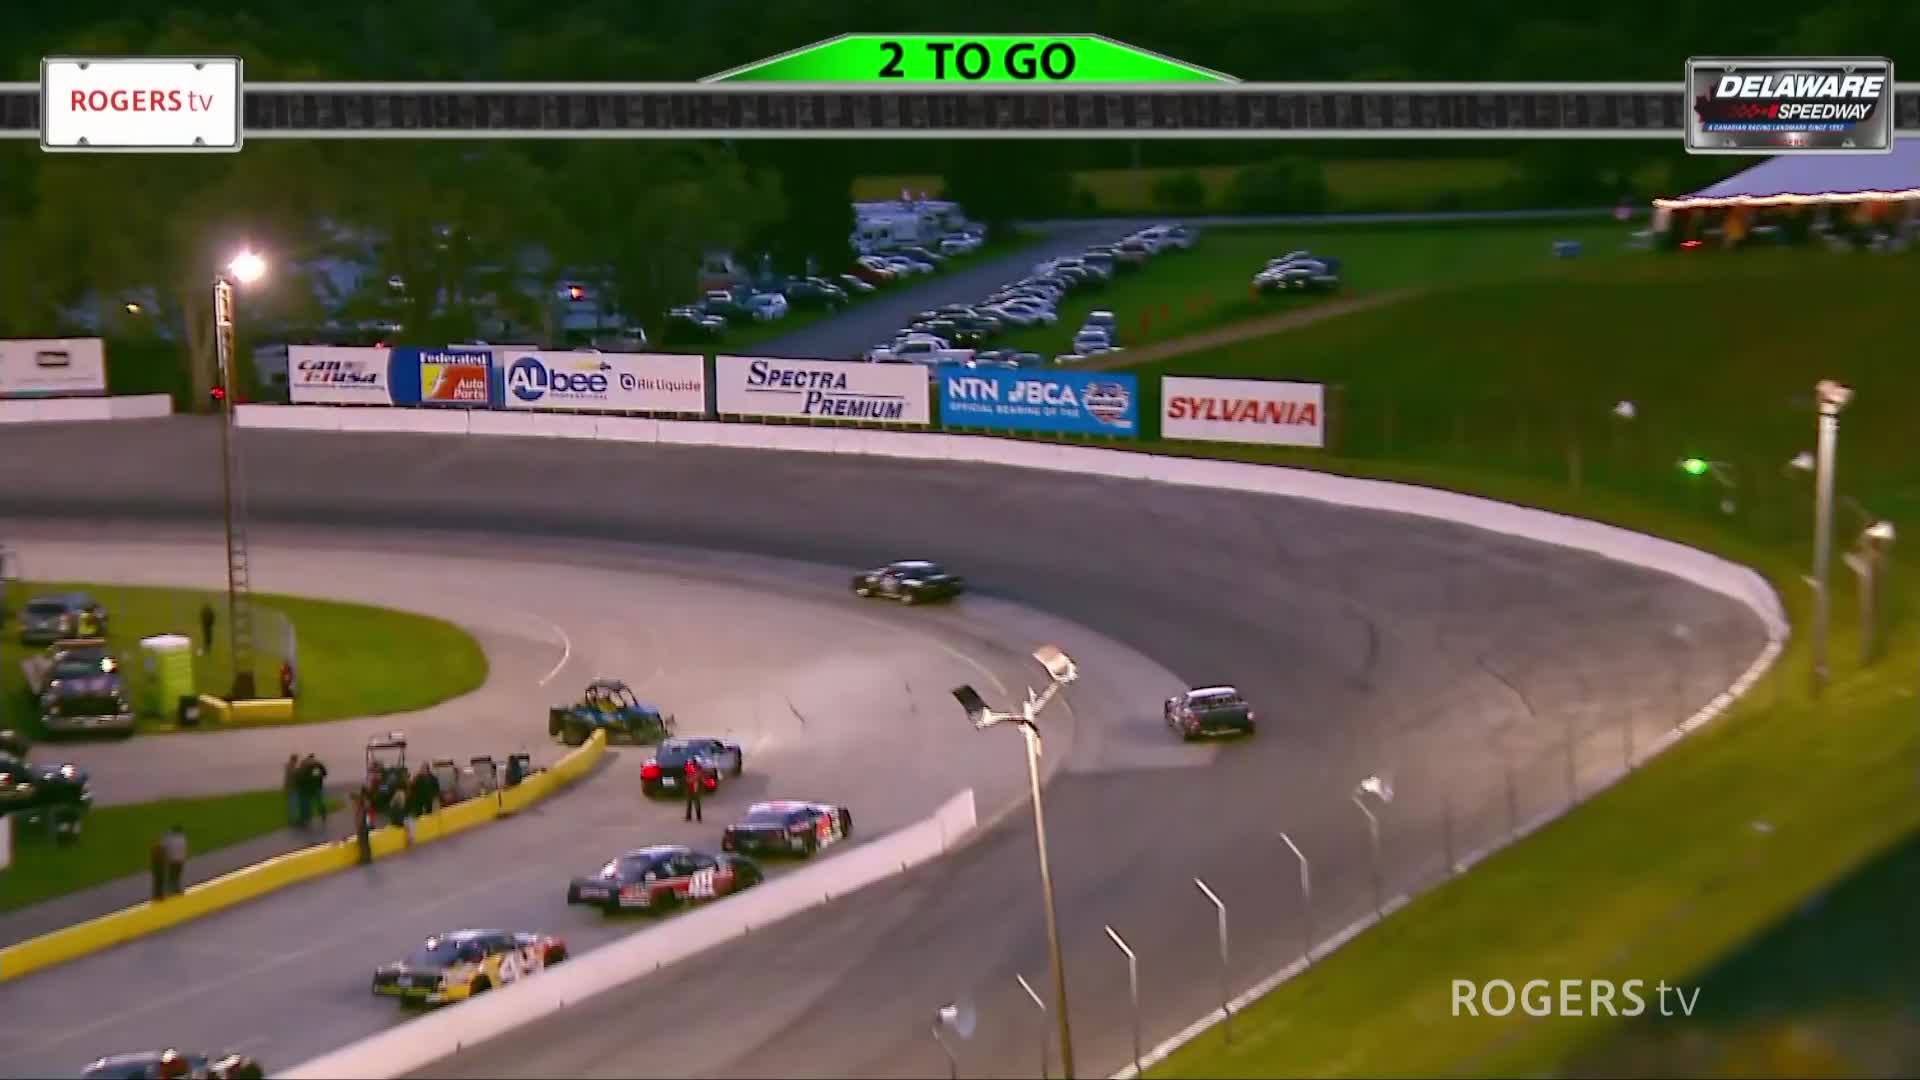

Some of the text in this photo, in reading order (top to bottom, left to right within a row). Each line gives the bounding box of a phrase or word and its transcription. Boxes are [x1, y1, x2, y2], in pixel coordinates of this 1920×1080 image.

[420, 352, 486, 364] Federated
[457, 377, 484, 389] Auto
[747, 360, 847, 389] SPECTRA
[453, 387, 484, 400] Parts
[949, 377, 998, 401] NTN
[801, 391, 903, 418] PREMIUM
[1168, 397, 1317, 426] SYLVANIA
